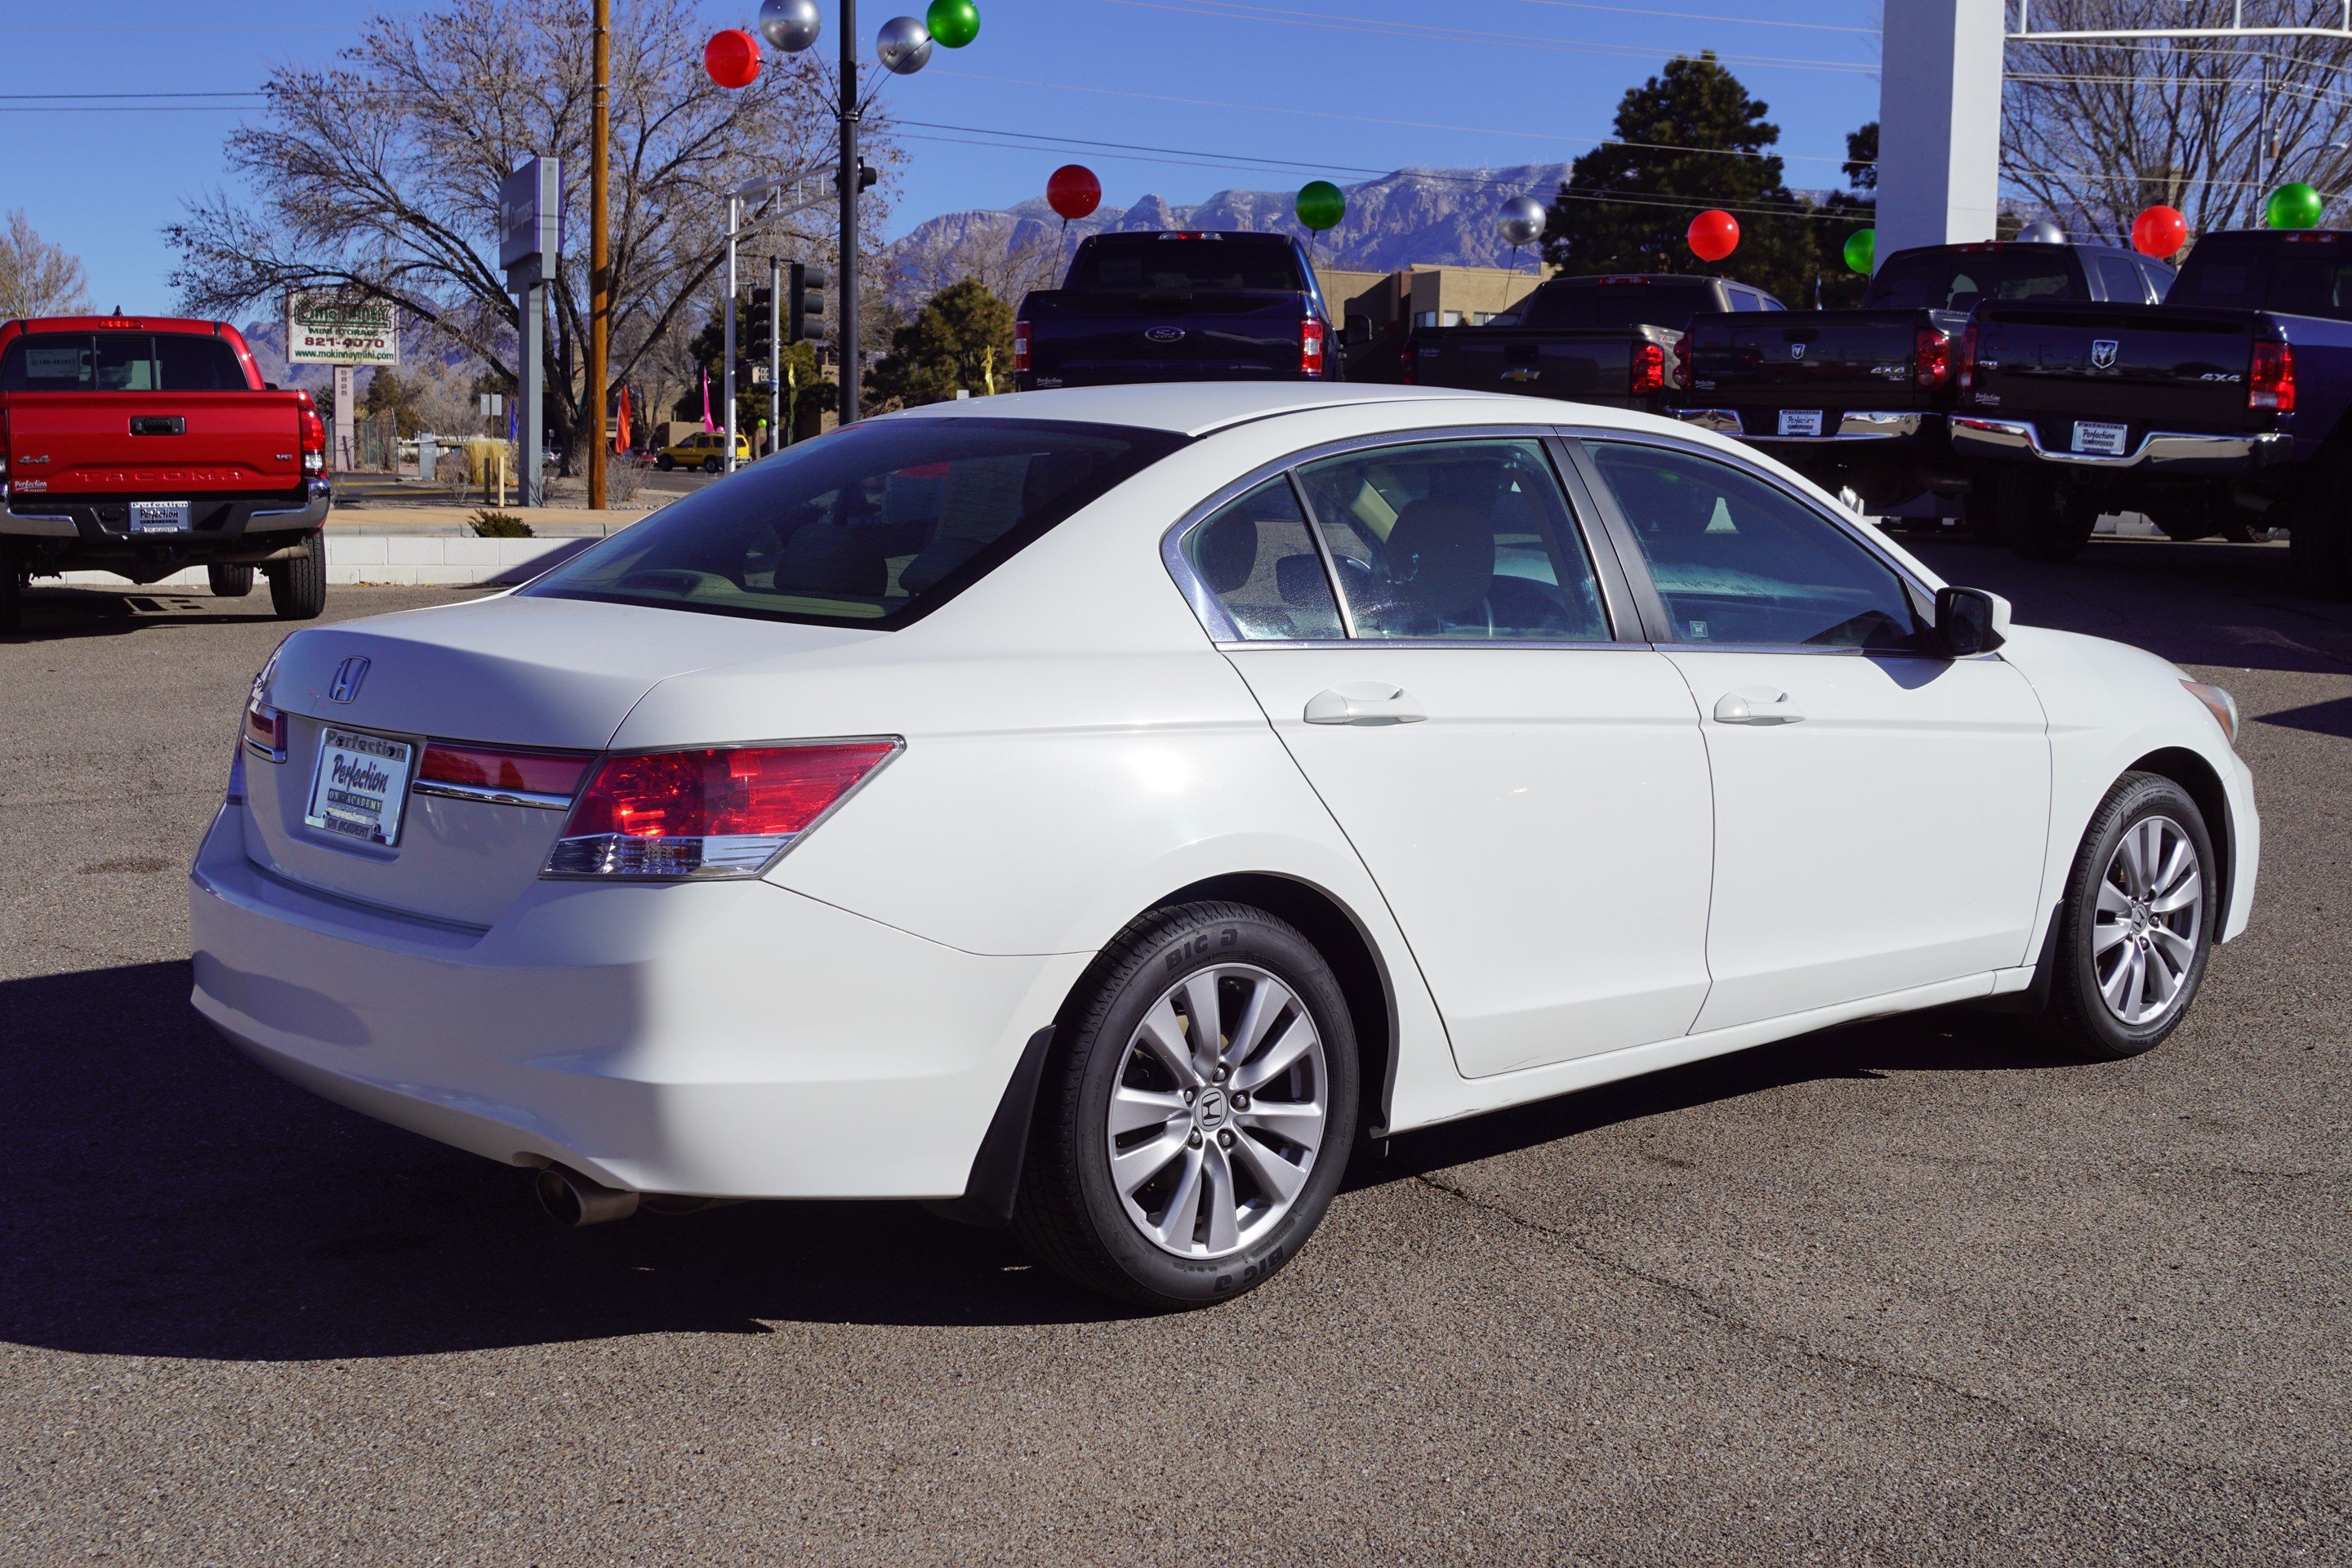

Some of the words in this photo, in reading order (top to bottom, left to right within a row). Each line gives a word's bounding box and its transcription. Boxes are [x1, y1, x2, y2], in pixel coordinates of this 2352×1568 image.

[305, 336, 385, 348] 821-4070
[1788, 416, 1814, 425] Perfection
[2082, 429, 2115, 439] Perfection
[15, 479, 47, 489] Perfection
[74, 470, 244, 482] TACOMA
[140, 509, 179, 520] Perfection
[326, 730, 407, 760] Perfection
[332, 755, 389, 793] Perfection
[328, 791, 339, 800] ON
[346, 794, 382, 809] ACADEMY
[2127, 797, 2155, 821] LEGACY
[327, 817, 338, 830] ON
[338, 821, 370, 838] ACADEMY
[1165, 934, 1209, 973] BIG
[1243, 1245, 1284, 1285] BIG
